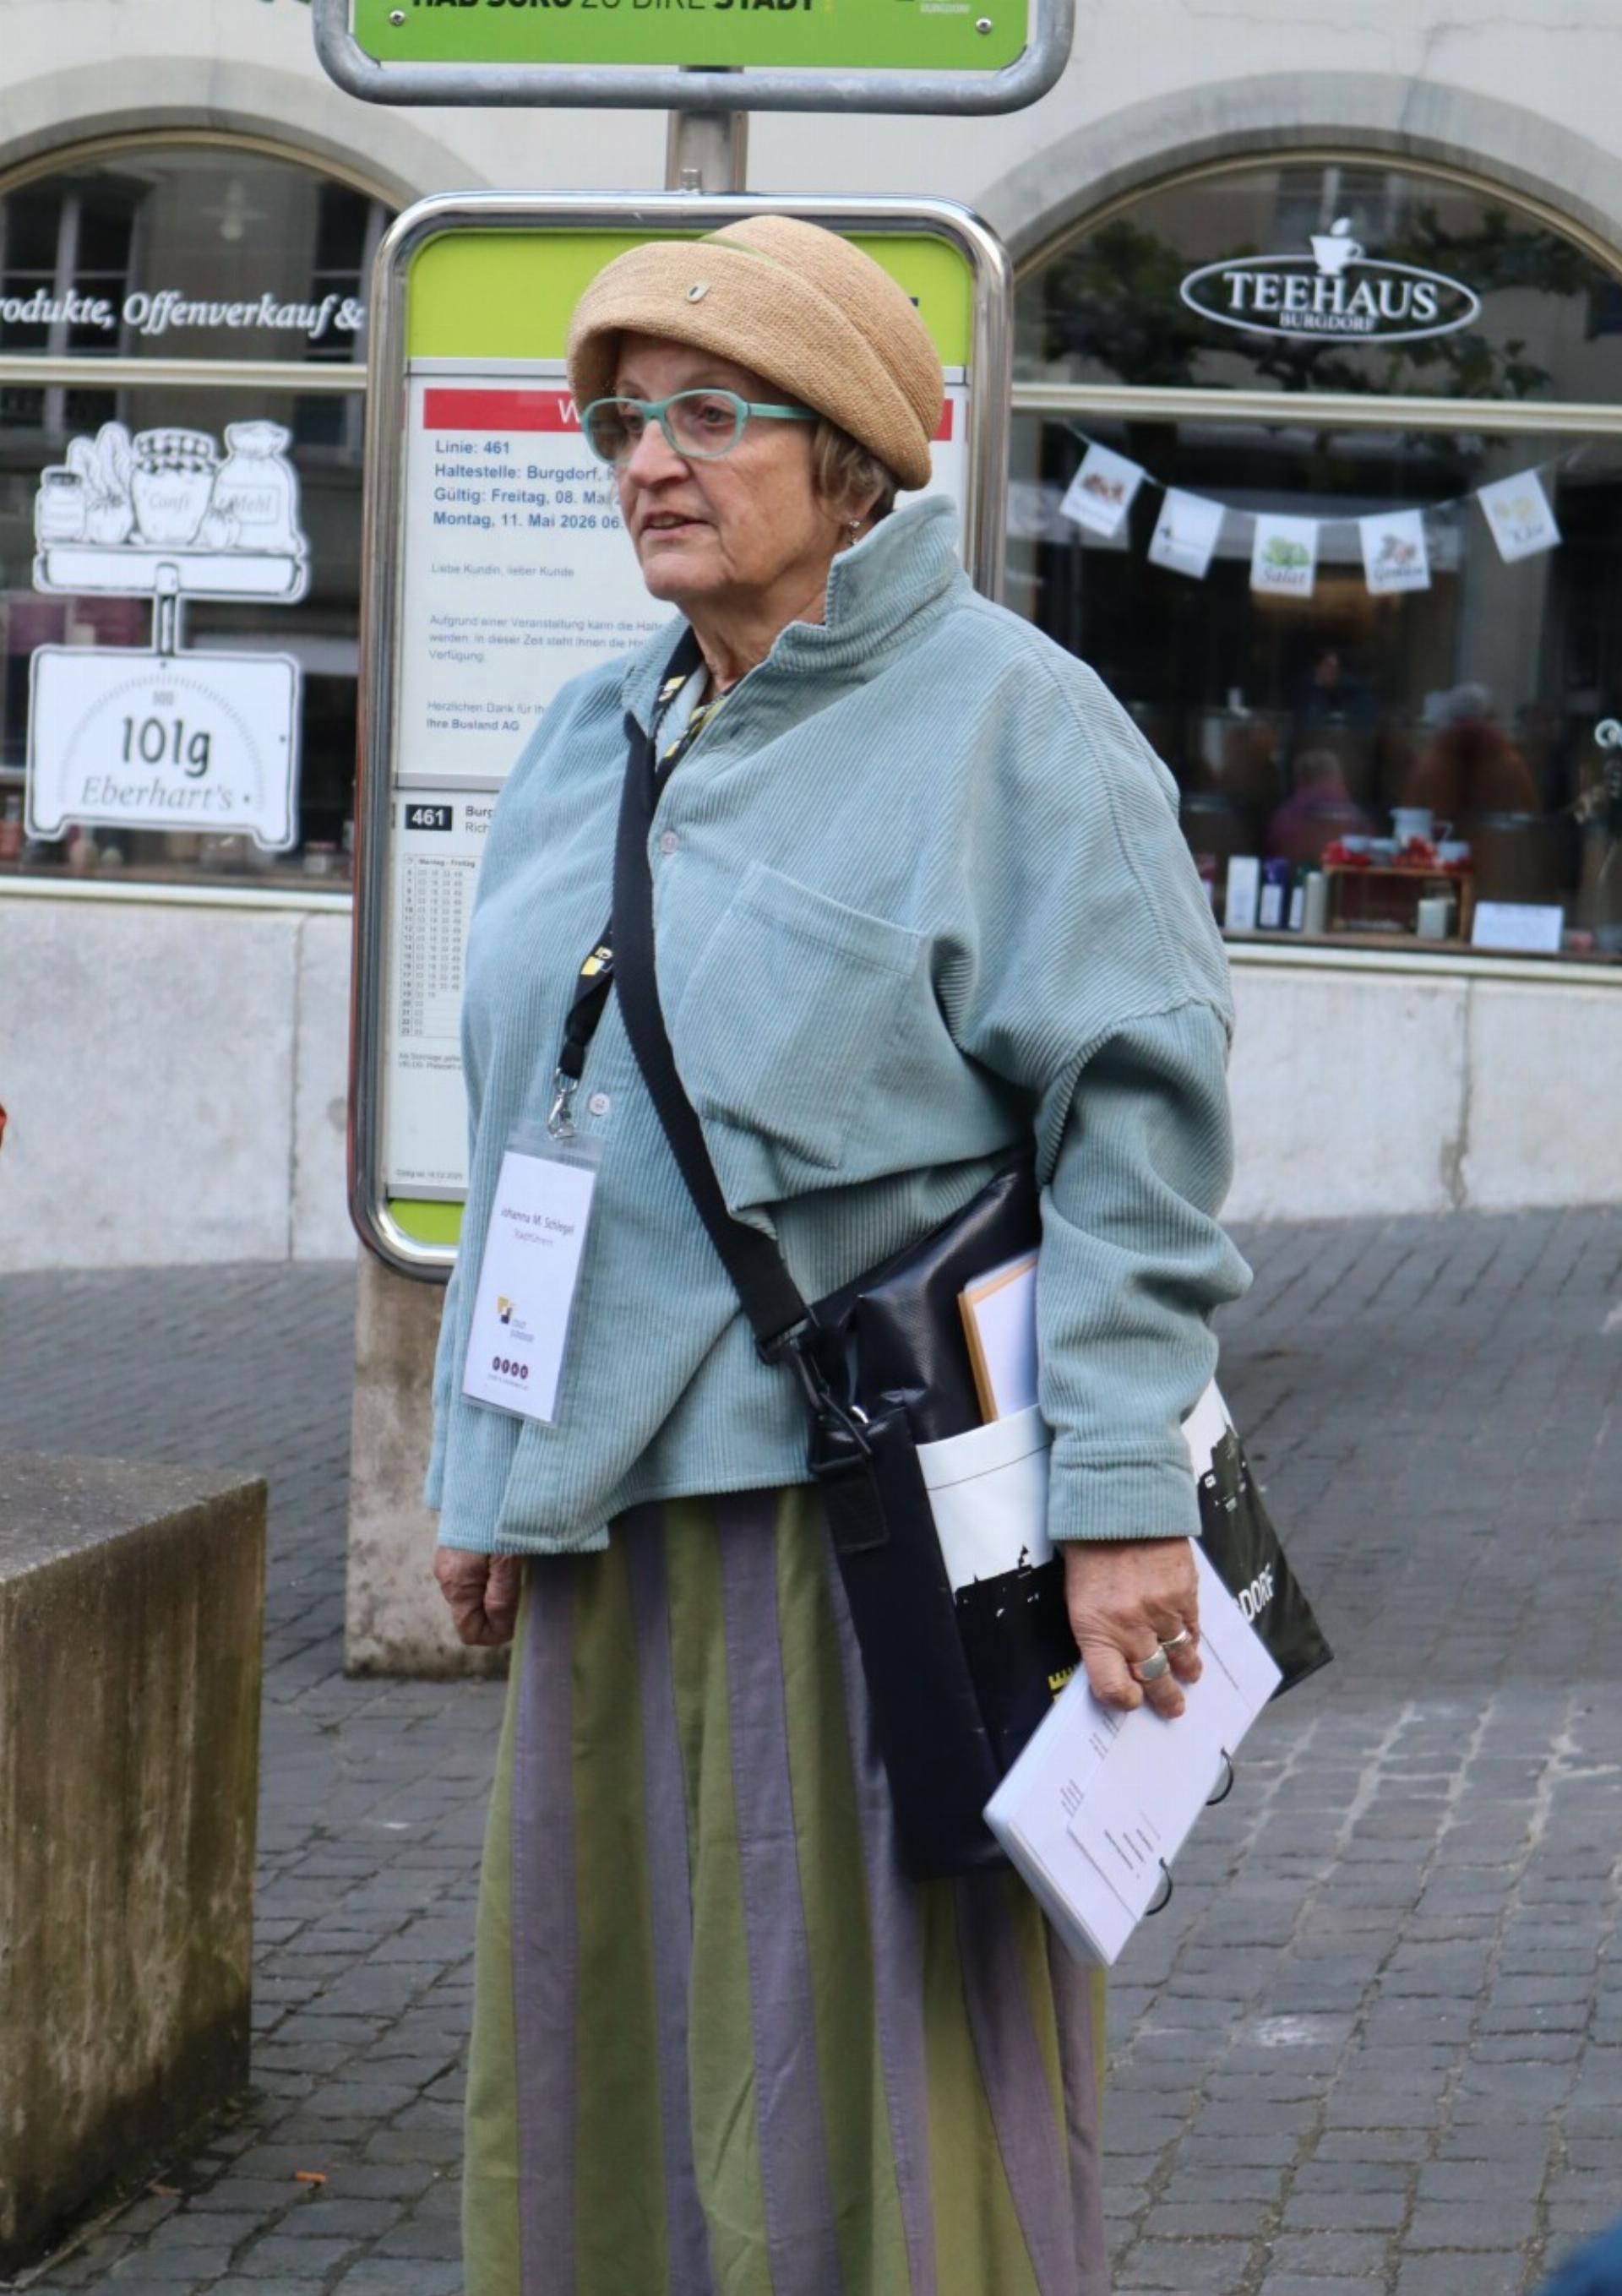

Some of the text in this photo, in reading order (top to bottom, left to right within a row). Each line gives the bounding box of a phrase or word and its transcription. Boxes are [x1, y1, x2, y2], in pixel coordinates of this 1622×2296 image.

[1222, 271, 1438, 322] TEEHAUS
[123, 291, 338, 338] Offenverkauf
[334, 297, 364, 330] &
[1278, 311, 1375, 333] BURGDORF
[435, 438, 510, 454] Linie: 461
[434, 463, 522, 479] Haltestelle:
[526, 465, 601, 483] Burgdorf,
[433, 487, 486, 505] Gültig:
[491, 487, 550, 507] Freitag,
[433, 510, 495, 530] Montag,
[501, 512, 523, 527] 11.
[528, 514, 556, 529] Mai
[560, 514, 596, 530] 2026
[540, 566, 574, 578] Kunde
[429, 614, 478, 628] Aufgrund
[481, 617, 508, 627] einer
[511, 617, 585, 632] Veranstaltung
[523, 634, 543, 645] Zeit
[486, 702, 514, 713] Dank
[426, 718, 449, 729] Ihre
[500, 721, 520, 732] AG
[122, 715, 210, 778] 101g
[81, 775, 233, 810] Eberhart's
[411, 808, 445, 827] 461
[1234, 1562, 1274, 1623] DORF
